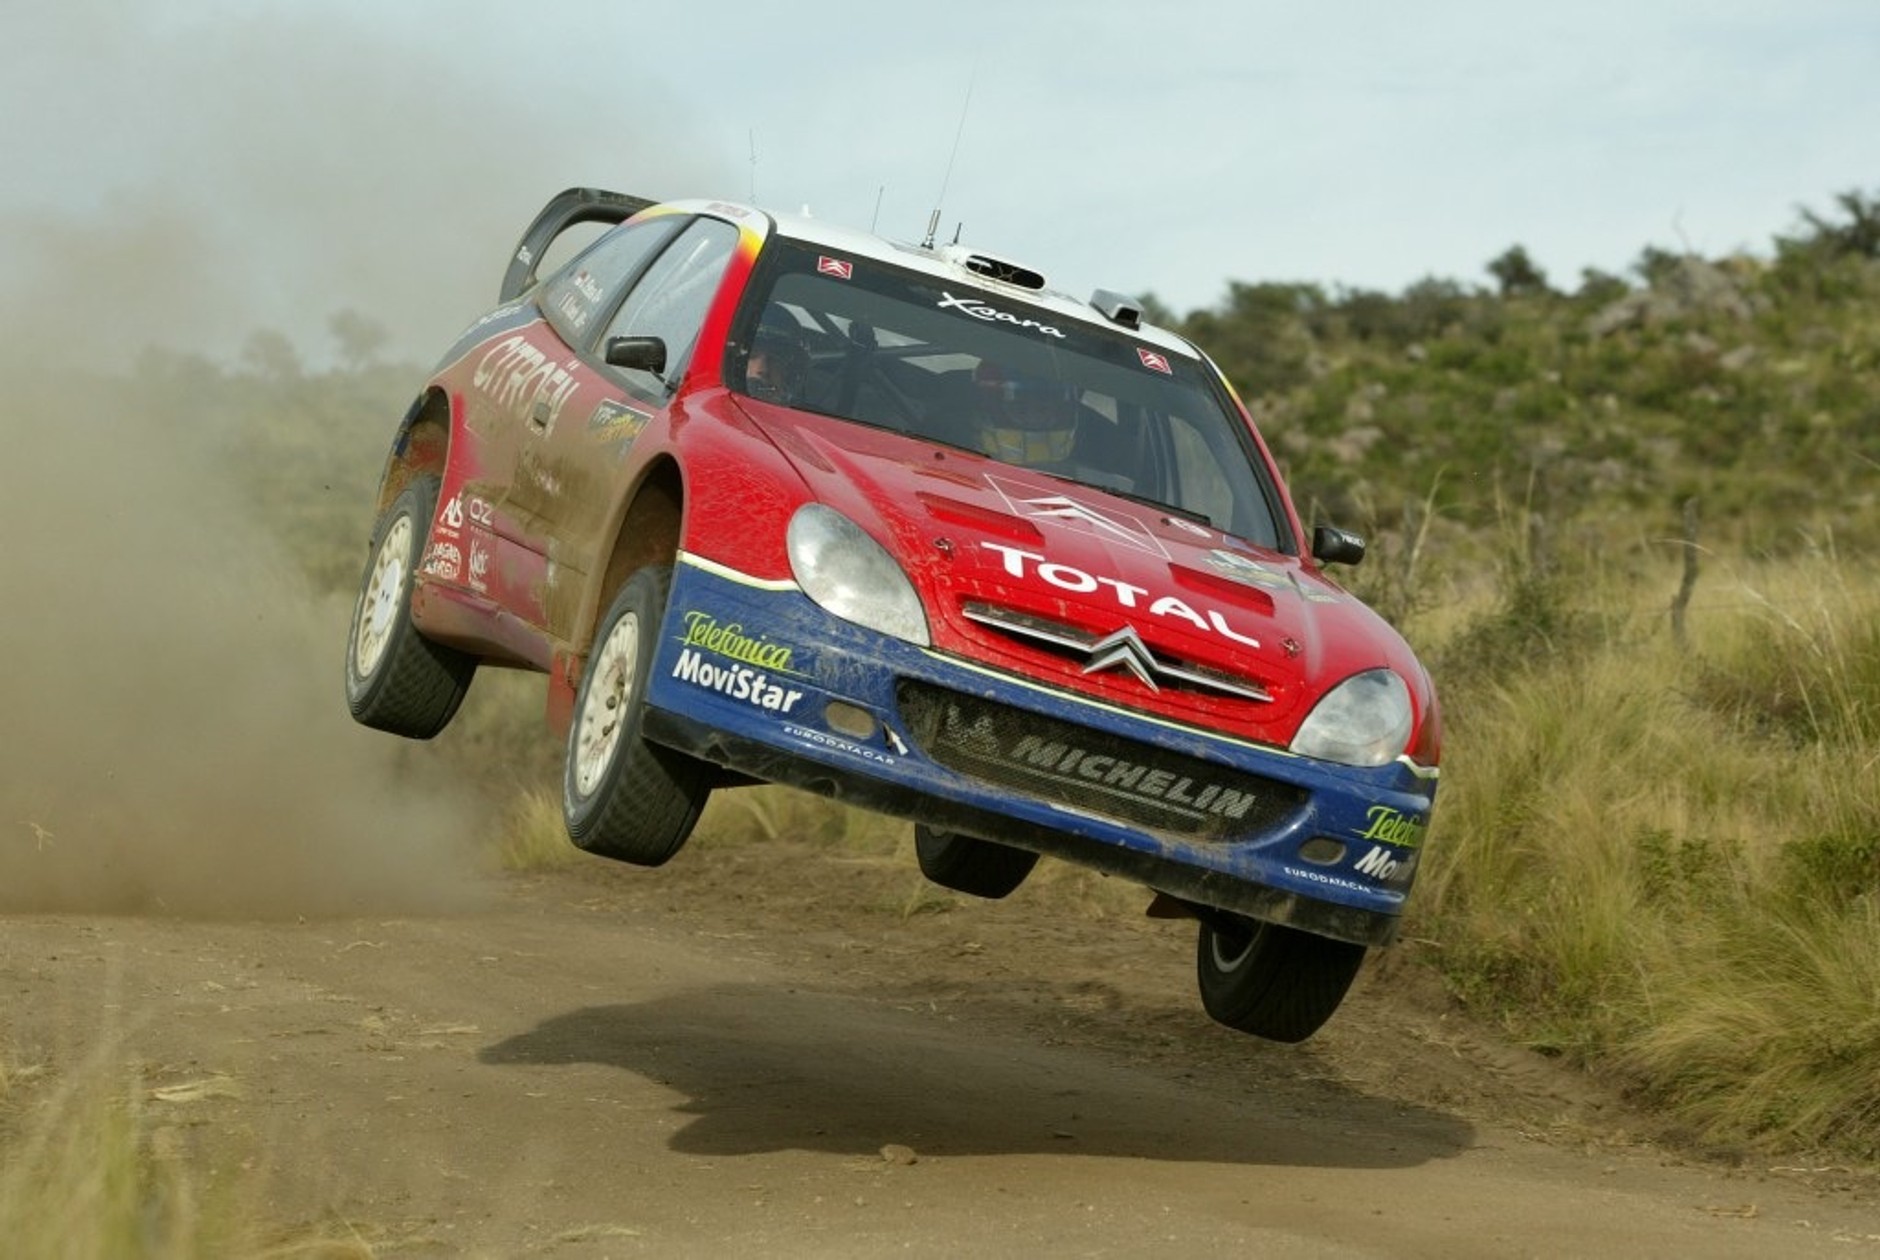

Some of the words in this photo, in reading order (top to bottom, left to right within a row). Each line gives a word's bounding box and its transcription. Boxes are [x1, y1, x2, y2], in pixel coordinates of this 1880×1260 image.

[937, 291, 1066, 338] Xsara
[981, 541, 1260, 649] TOTAL
[672, 648, 803, 713] MoviStar
[783, 726, 896, 765] EURODATACAR
[1011, 735, 1257, 820] MICHELIN
